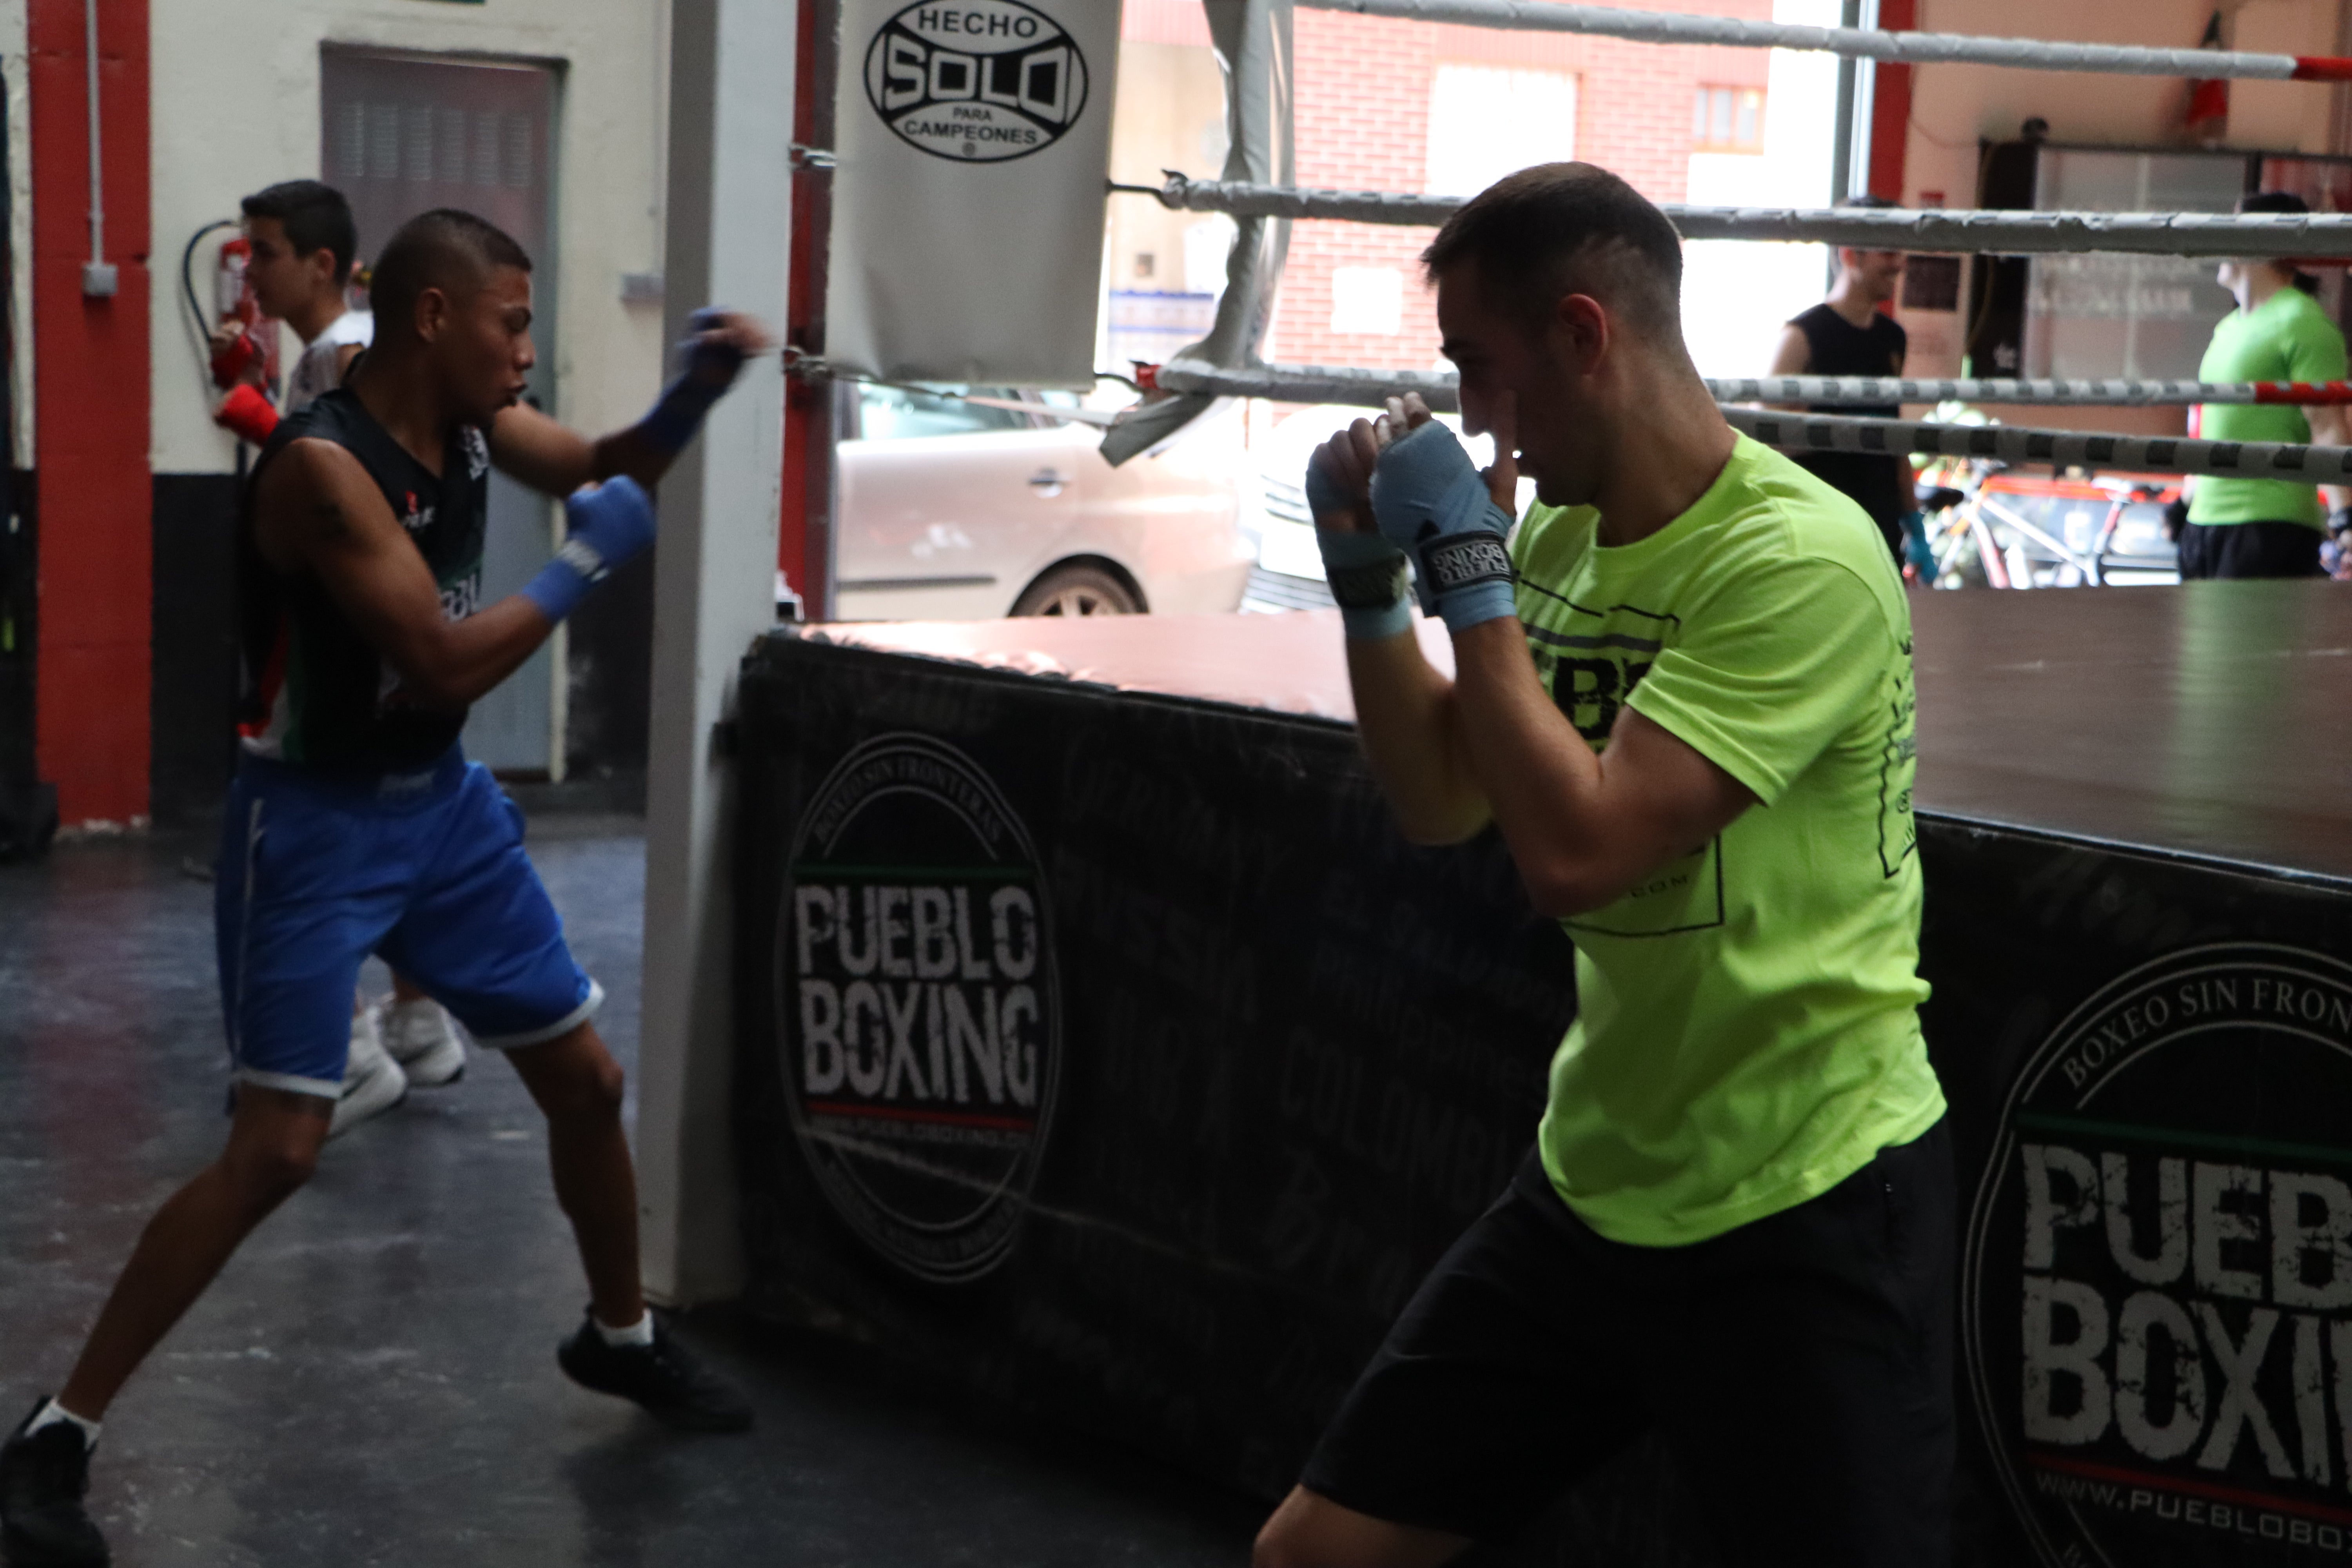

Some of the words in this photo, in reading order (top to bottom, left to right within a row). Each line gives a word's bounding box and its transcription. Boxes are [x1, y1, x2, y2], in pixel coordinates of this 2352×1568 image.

[918, 9, 1038, 38] HECHO
[884, 33, 1071, 125] SOLO
[952, 107, 993, 122] PARA
[904, 120, 1038, 144] CAMPEONES
[795, 884, 1038, 981] PUEBLO
[798, 978, 1040, 1109] BOXING
[2061, 994, 2170, 1089] BOXEO
[2179, 977, 2238, 1016] SIN
[2020, 1142, 2352, 1311] PUEB
[2034, 1472, 2352, 1552] WWW.PUEBLOBO
